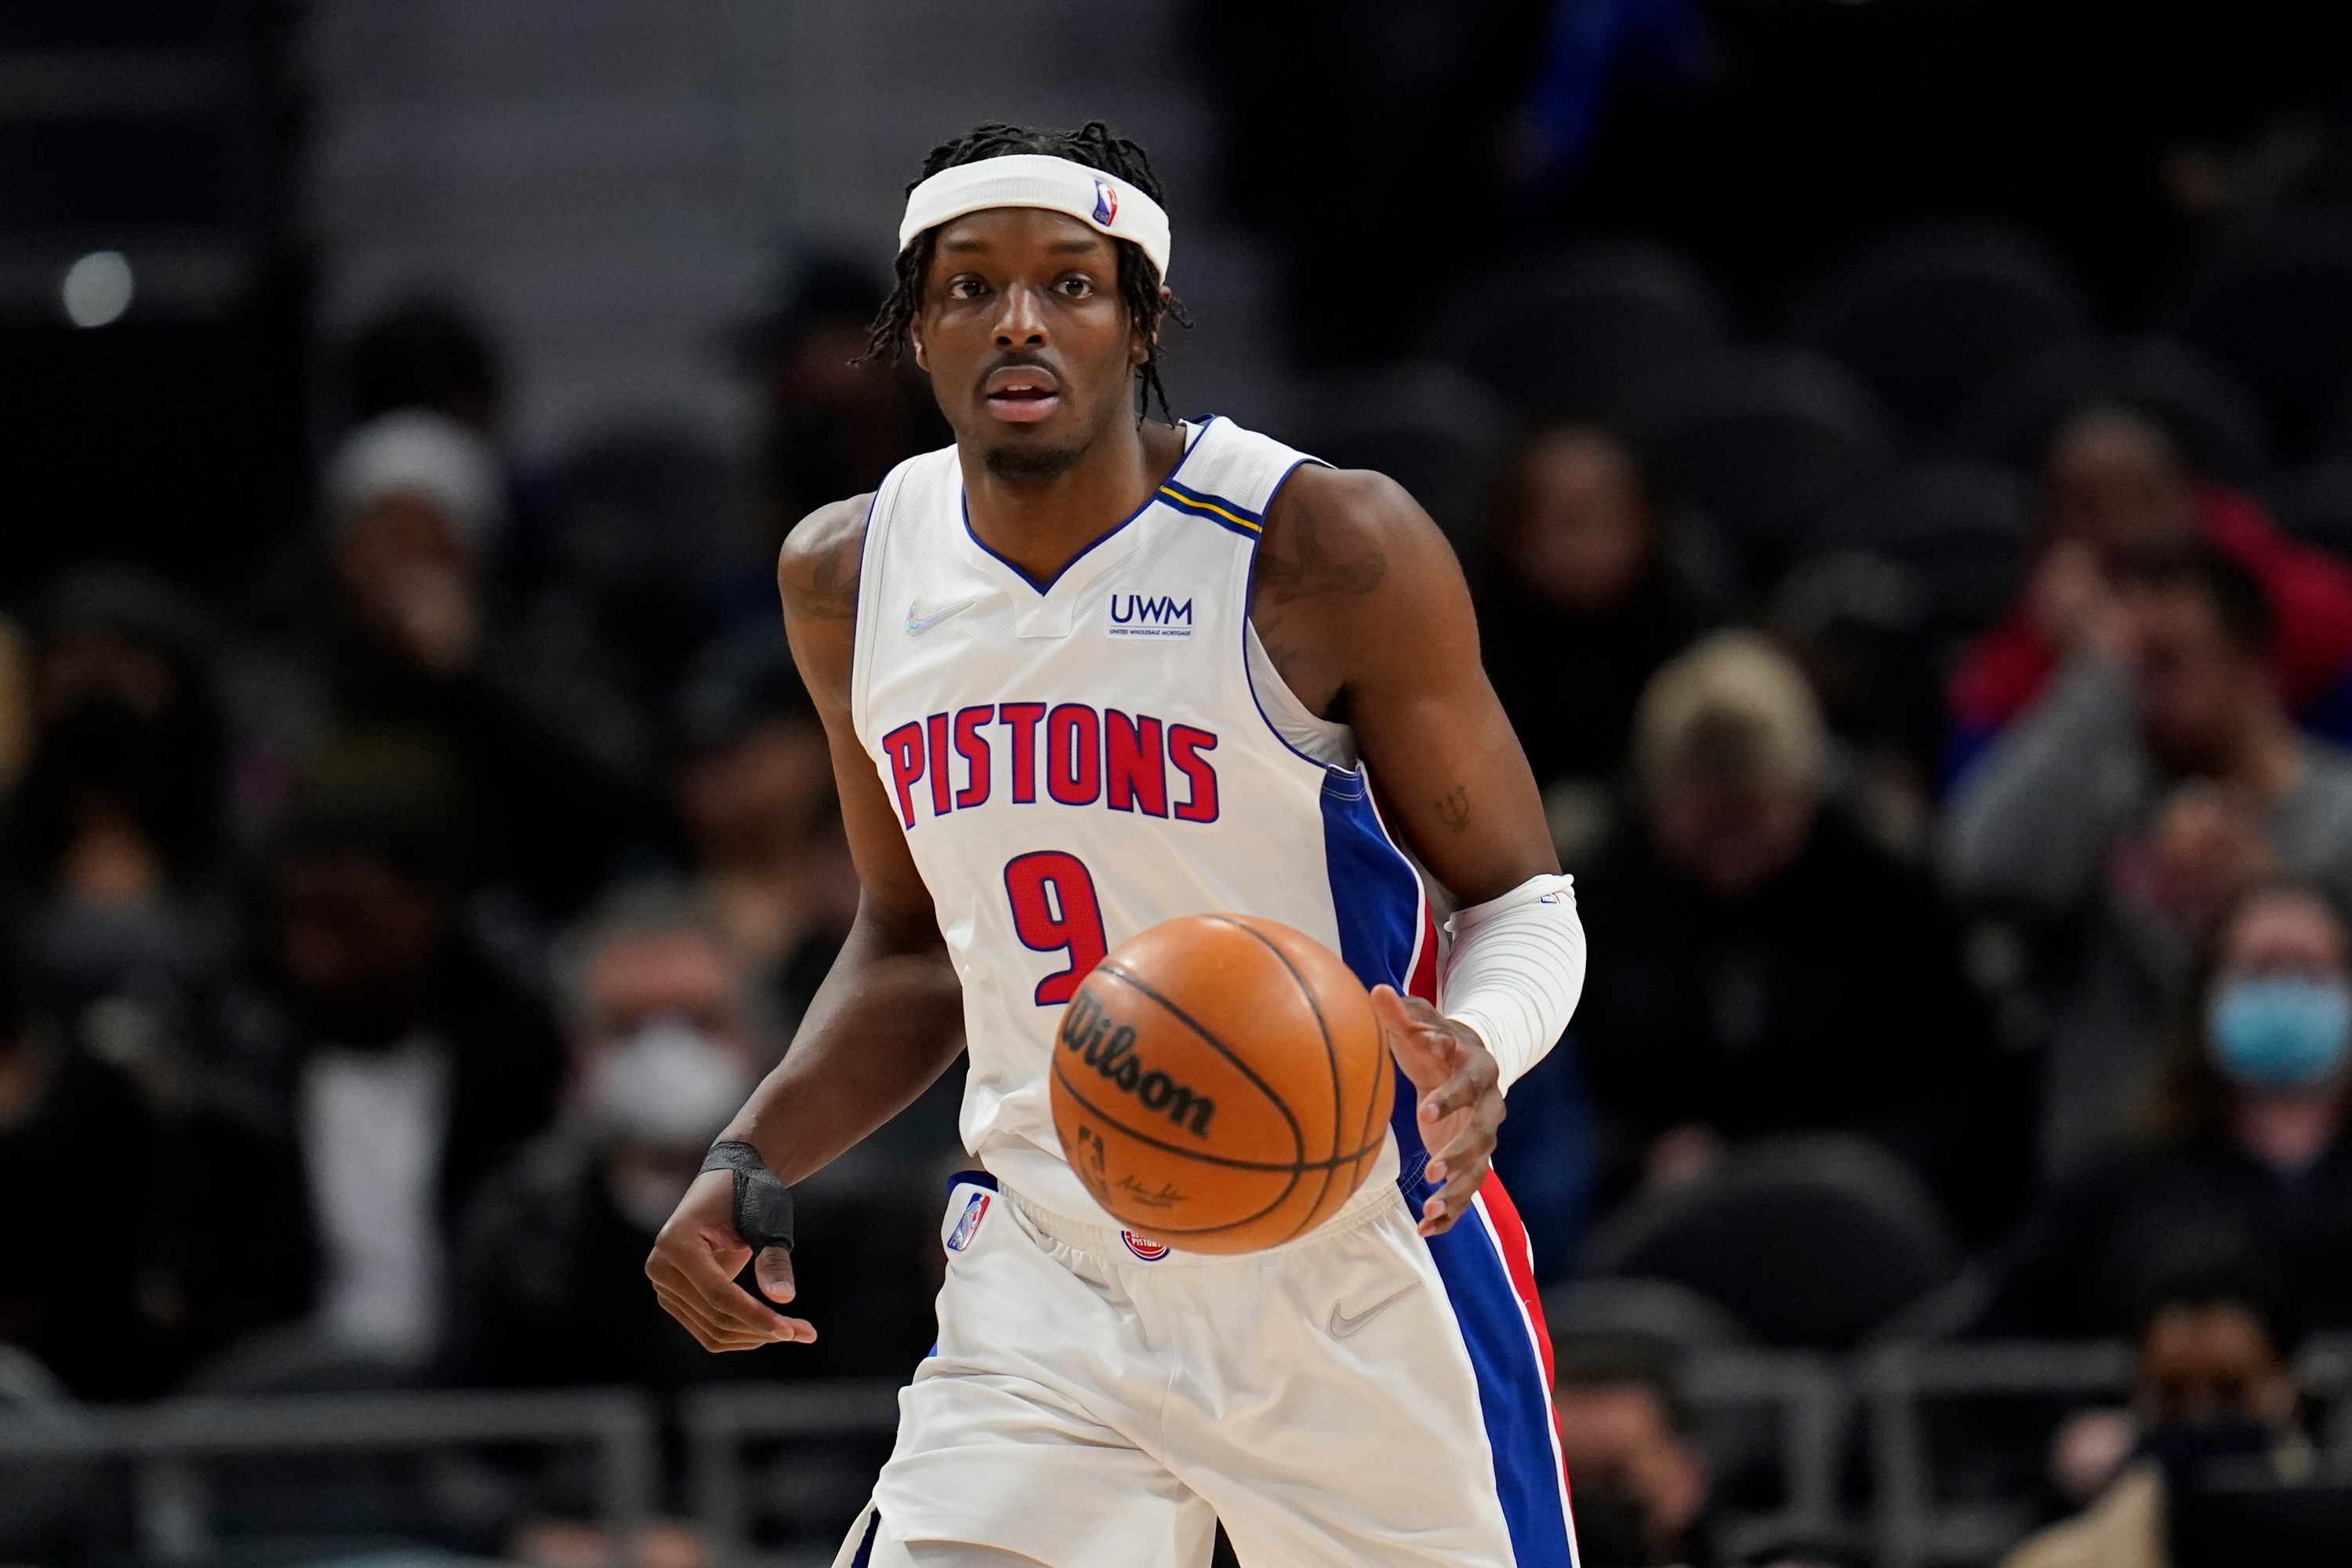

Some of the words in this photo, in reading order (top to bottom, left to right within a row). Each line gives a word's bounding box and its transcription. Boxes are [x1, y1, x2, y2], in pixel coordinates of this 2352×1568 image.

[1111, 594, 1192, 625] UWM
[882, 702, 1219, 830] PISTONS
[1004, 850, 1108, 1007] 9
[1061, 988, 1215, 1138] Wilson
